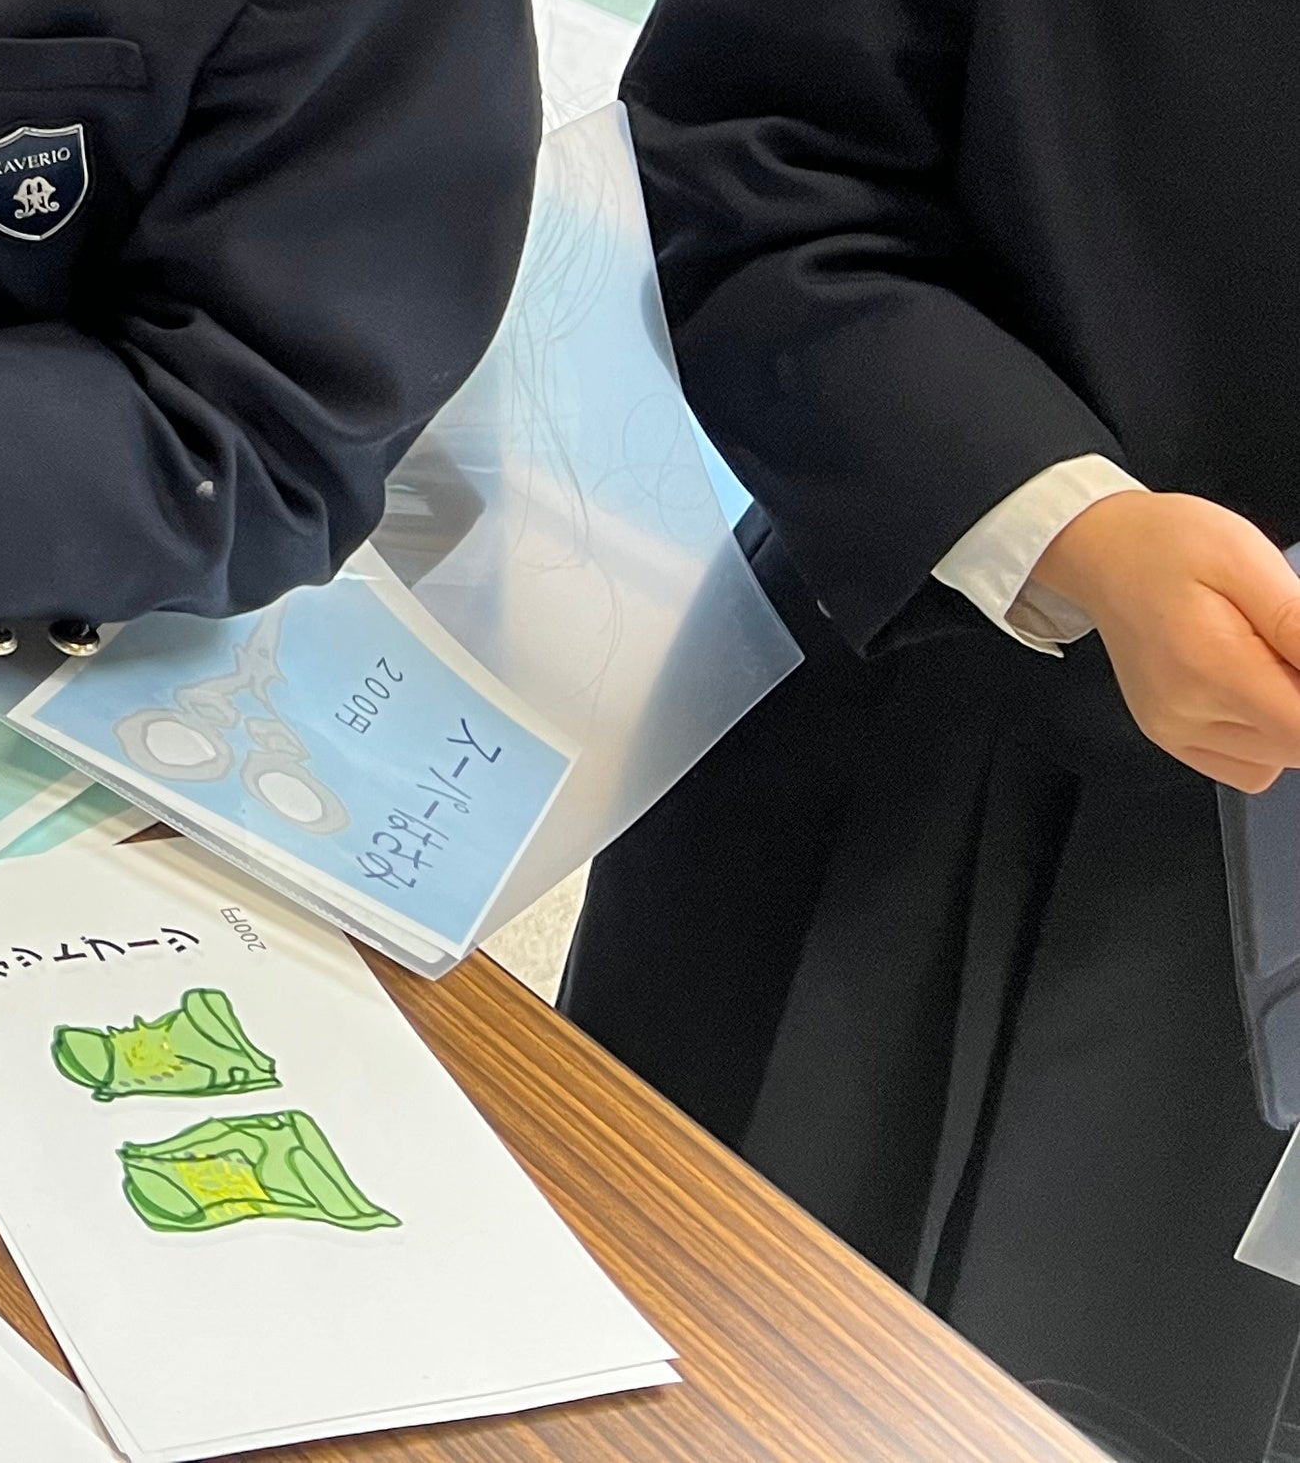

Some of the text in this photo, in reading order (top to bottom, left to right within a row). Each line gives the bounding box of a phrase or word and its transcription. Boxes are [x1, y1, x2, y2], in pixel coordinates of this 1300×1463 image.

[334, 656, 405, 735] 200円
[355, 717, 504, 891] スーパーはさみ
[220, 905, 268, 953] 200円
